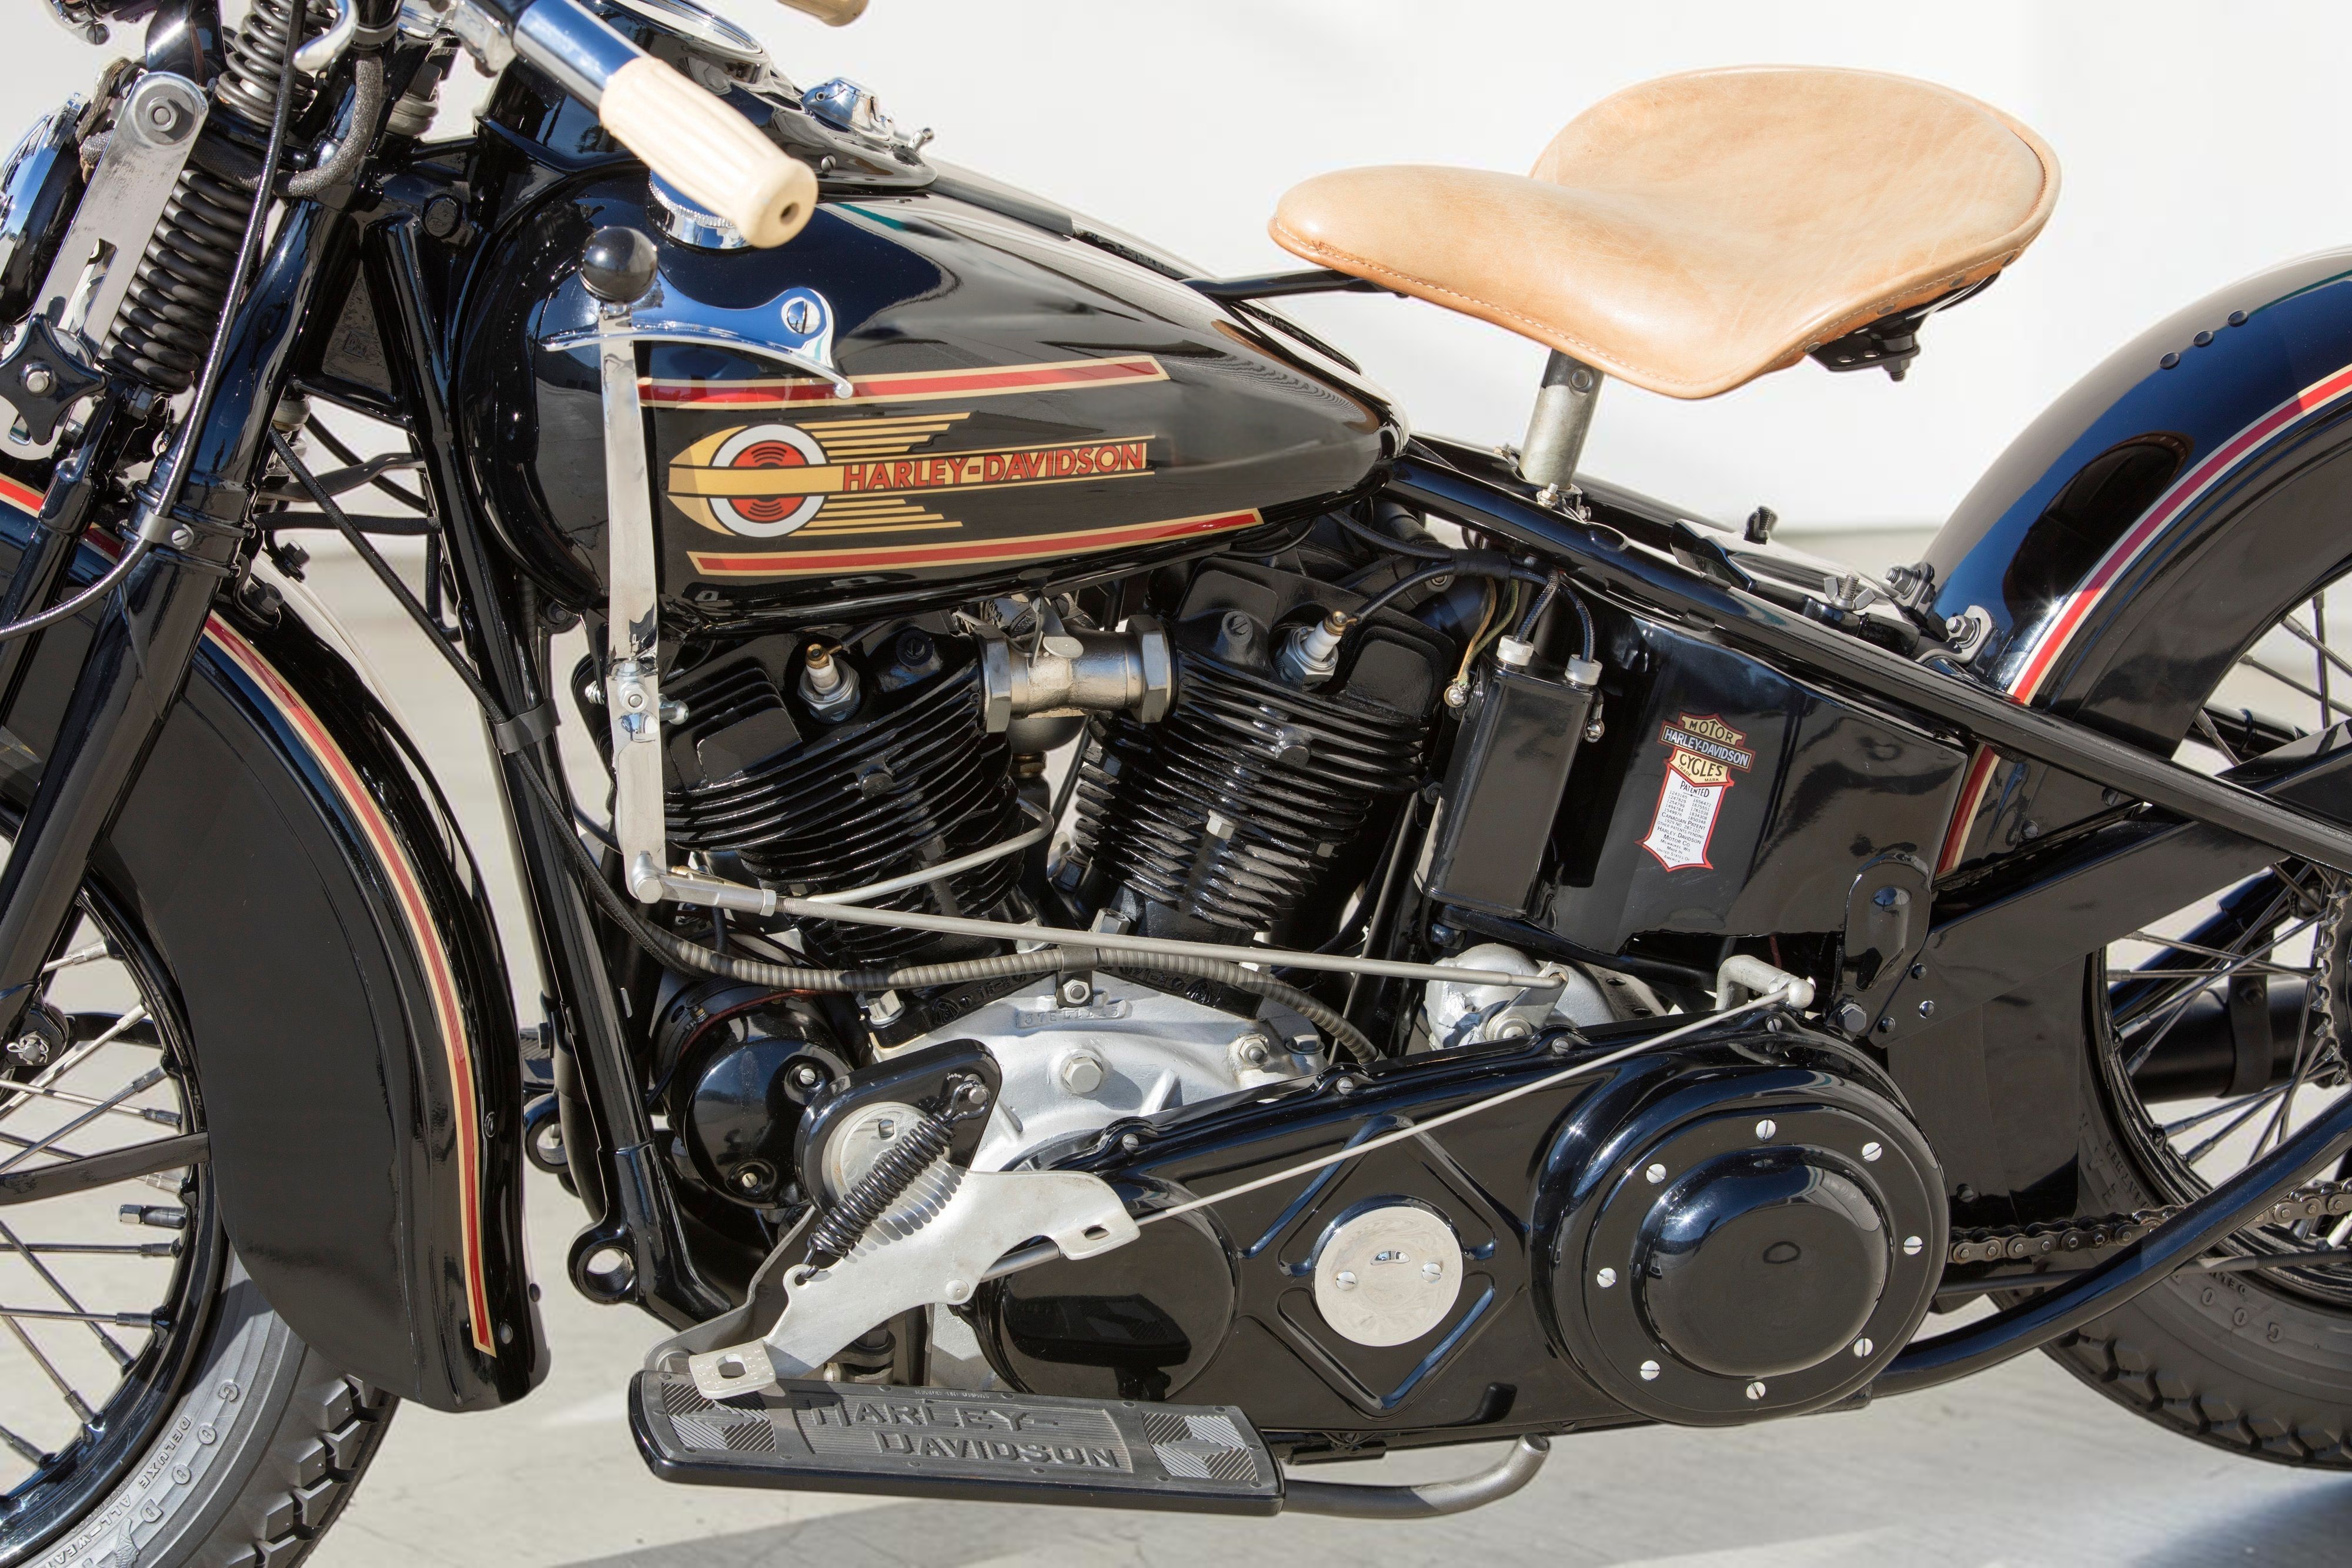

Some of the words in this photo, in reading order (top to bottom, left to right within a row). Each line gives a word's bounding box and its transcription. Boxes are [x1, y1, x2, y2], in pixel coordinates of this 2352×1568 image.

[843, 443, 1143, 492] HARLEY-DAVIDSON
[1689, 720, 1734, 743] MOTOR
[1664, 729, 1749, 766] HARLEY-DAVIDSON
[1678, 765, 1692, 777] TRADE
[1680, 754, 1723, 777] CYCLES
[1680, 781, 1710, 797] PATENTED
[1688, 820, 1706, 830] PATENT
[139, 1416, 193, 1489] DELUXE
[141, 1380, 240, 1523] GOOD
[873, 1430, 1120, 1469] DAVIDSON
